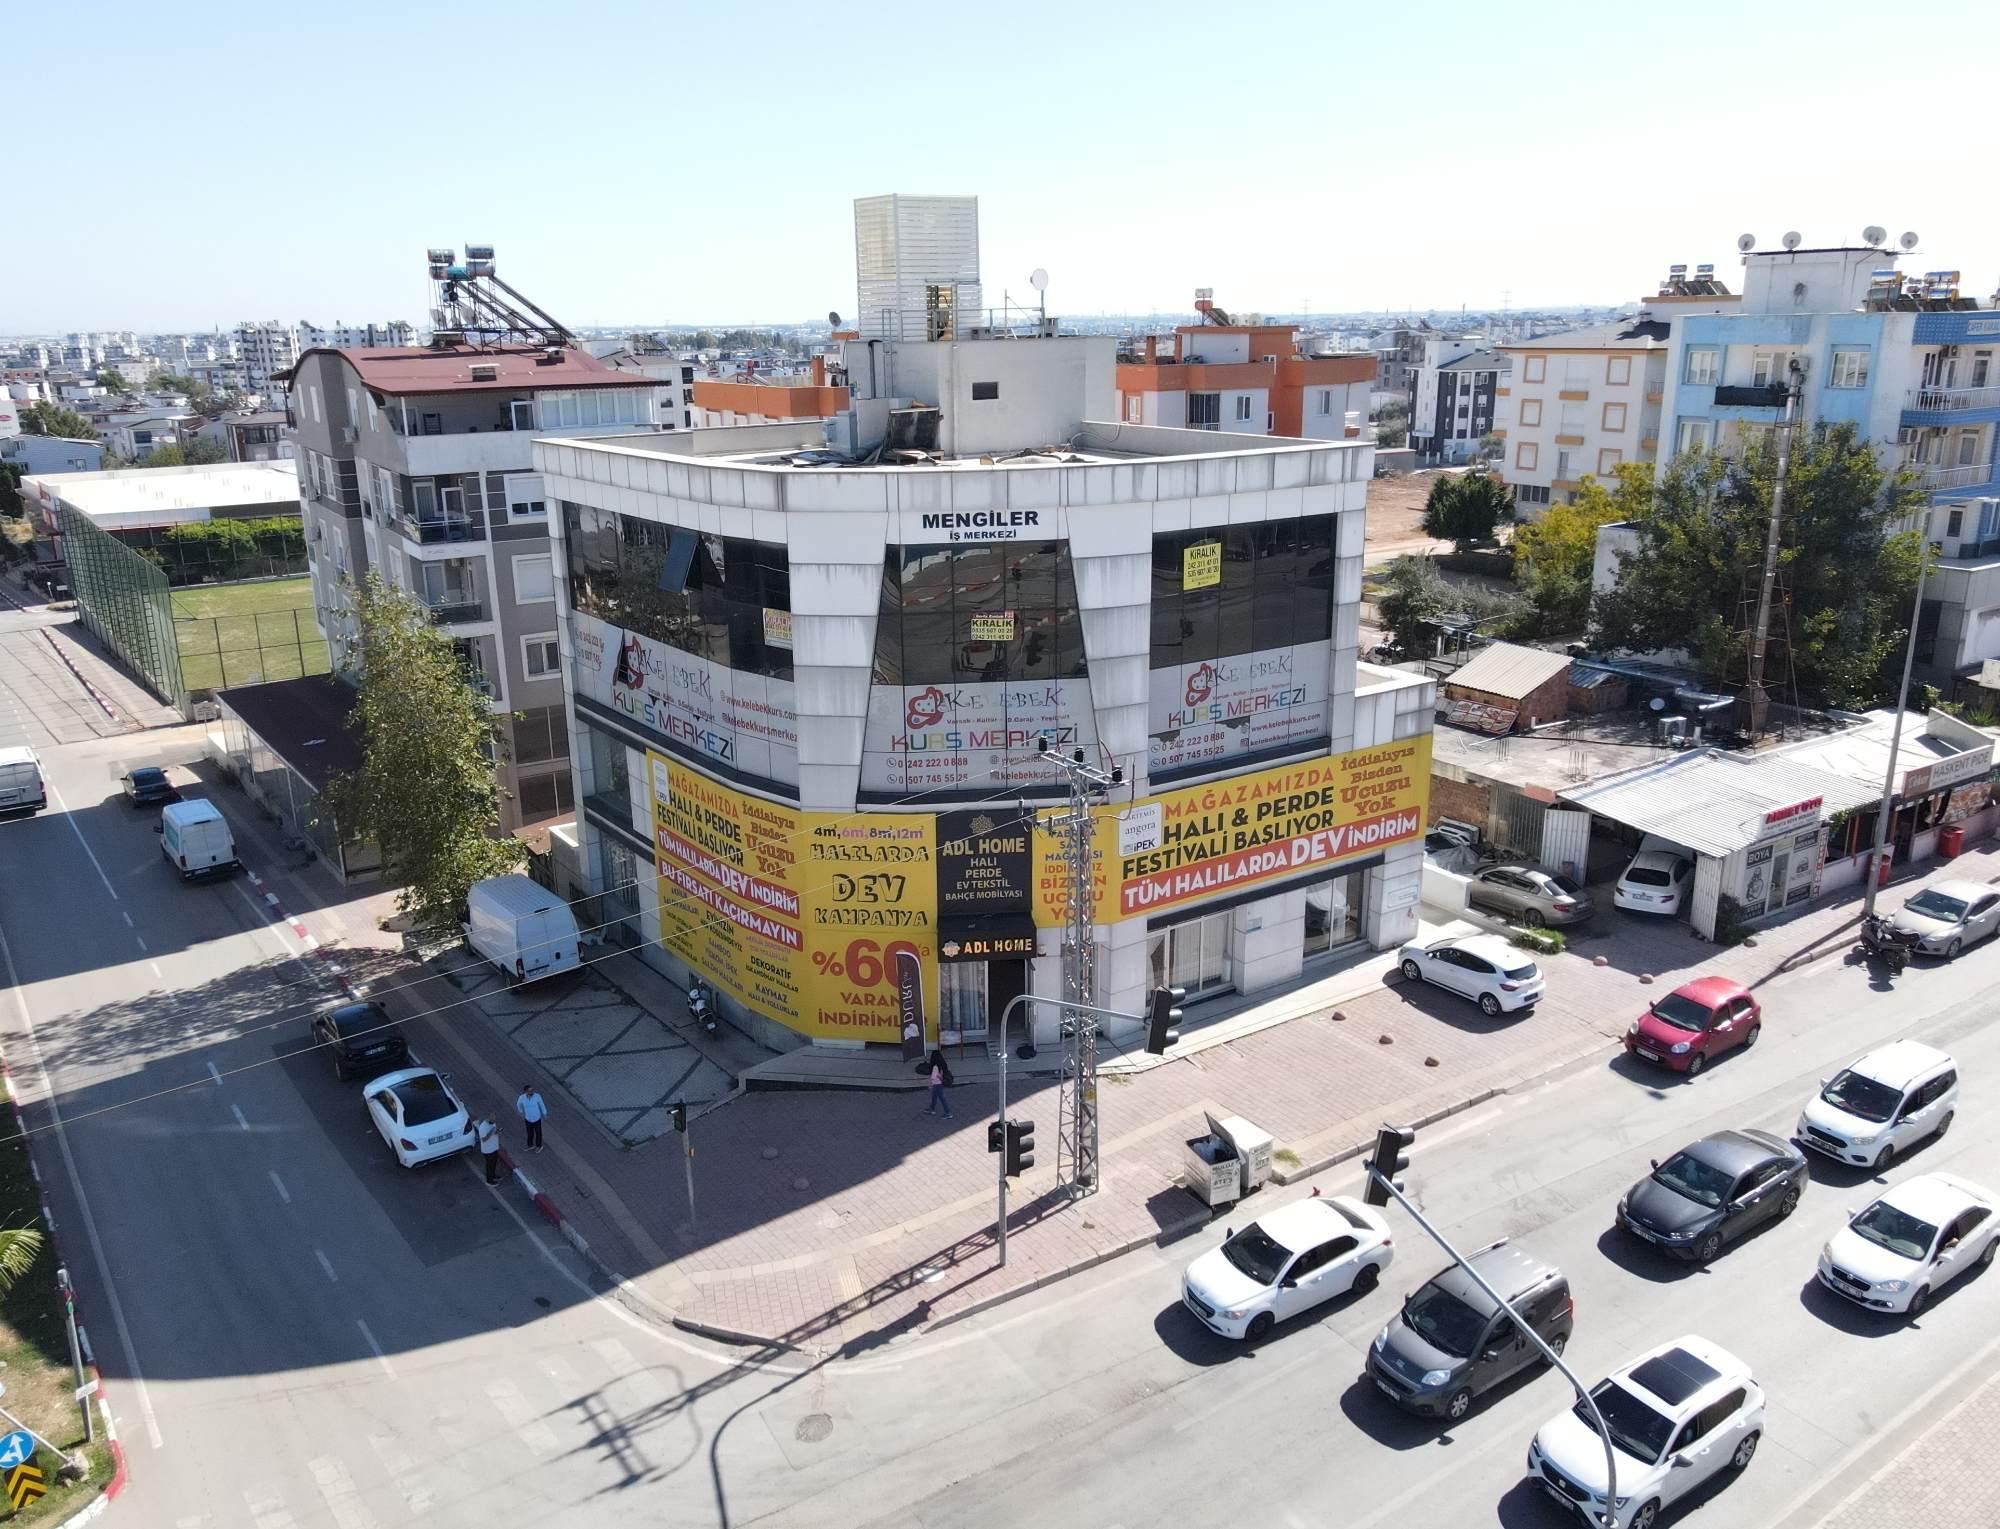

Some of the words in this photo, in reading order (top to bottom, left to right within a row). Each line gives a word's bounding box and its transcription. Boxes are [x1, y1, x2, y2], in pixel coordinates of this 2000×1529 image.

[922, 510, 1039, 528] MENGİLER
[950, 532, 960, 541] İŞ
[964, 529, 1017, 540] MERKEZİ
[1168, 704, 1222, 728] KURS
[1227, 684, 1306, 717] MERKEZİ
[613, 688, 656, 722] KURS
[659, 709, 734, 761] MERKEZİ
[891, 731, 962, 751] KURS
[970, 723, 1078, 748] MERKEZİ
[1187, 737, 1201, 746] 222
[908, 760, 923, 768] 242
[926, 759, 941, 767] 222
[1169, 754, 1183, 763] 507
[1187, 750, 1201, 759] 745
[908, 775, 923, 784] 507
[926, 774, 941, 783] 745
[1350, 764, 1403, 784] Bizden
[668, 769, 739, 818] MAĞAZAMIZDA
[1165, 767, 1334, 820] MAĞAZAMIZDA
[1340, 776, 1411, 803] Ucuzu
[669, 789, 692, 817] HALI
[695, 805, 702, 822] &
[705, 809, 742, 843] PERDE
[1163, 812, 1224, 845] HALI
[1232, 808, 1249, 827] &
[1257, 786, 1334, 822] PERDE
[1354, 795, 1396, 816] Yok
[657, 804, 696, 840] FESTİVALİ
[698, 831, 744, 867] BAŞLIYOR
[1125, 822, 1156, 836] angora
[810, 843, 929, 863] HALILARDA
[942, 839, 974, 856] ADL
[978, 837, 1025, 854] HOME
[1123, 831, 1227, 880] FESTİVALİ
[1234, 809, 1333, 851] BAŞLIYOR
[970, 857, 997, 867] HALI
[1125, 878, 1171, 908] TÜM
[1175, 848, 1287, 895] HALILARDA
[1291, 827, 1346, 866] DEV
[1347, 813, 1417, 848] İNDİRİM
[1747, 848, 1771, 864] BOYA
[659, 830, 676, 854] TÜM
[677, 845, 720, 879] HALILARDA
[720, 864, 748, 896] DEV
[750, 878, 797, 914] İNDİRİM
[756, 856, 786, 879] Yok
[965, 868, 1002, 879] PERDE
[832, 873, 906, 903] DEV
[956, 882, 971, 890] EV
[973, 878, 1012, 889] TEKSTİL
[662, 860, 675, 879] BU
[677, 870, 713, 903] FIRSATI
[715, 894, 797, 944] KAÇIRMAYIN
[945, 892, 975, 901] BAHÇE
[976, 889, 1023, 899] MOBİLYASI
[815, 908, 928, 926] KAMPANYA
[964, 941, 990, 954] ADL
[994, 939, 1033, 952] HOME
[751, 955, 792, 980] DEKORATİF
[755, 982, 788, 1004] KAYMAZ
